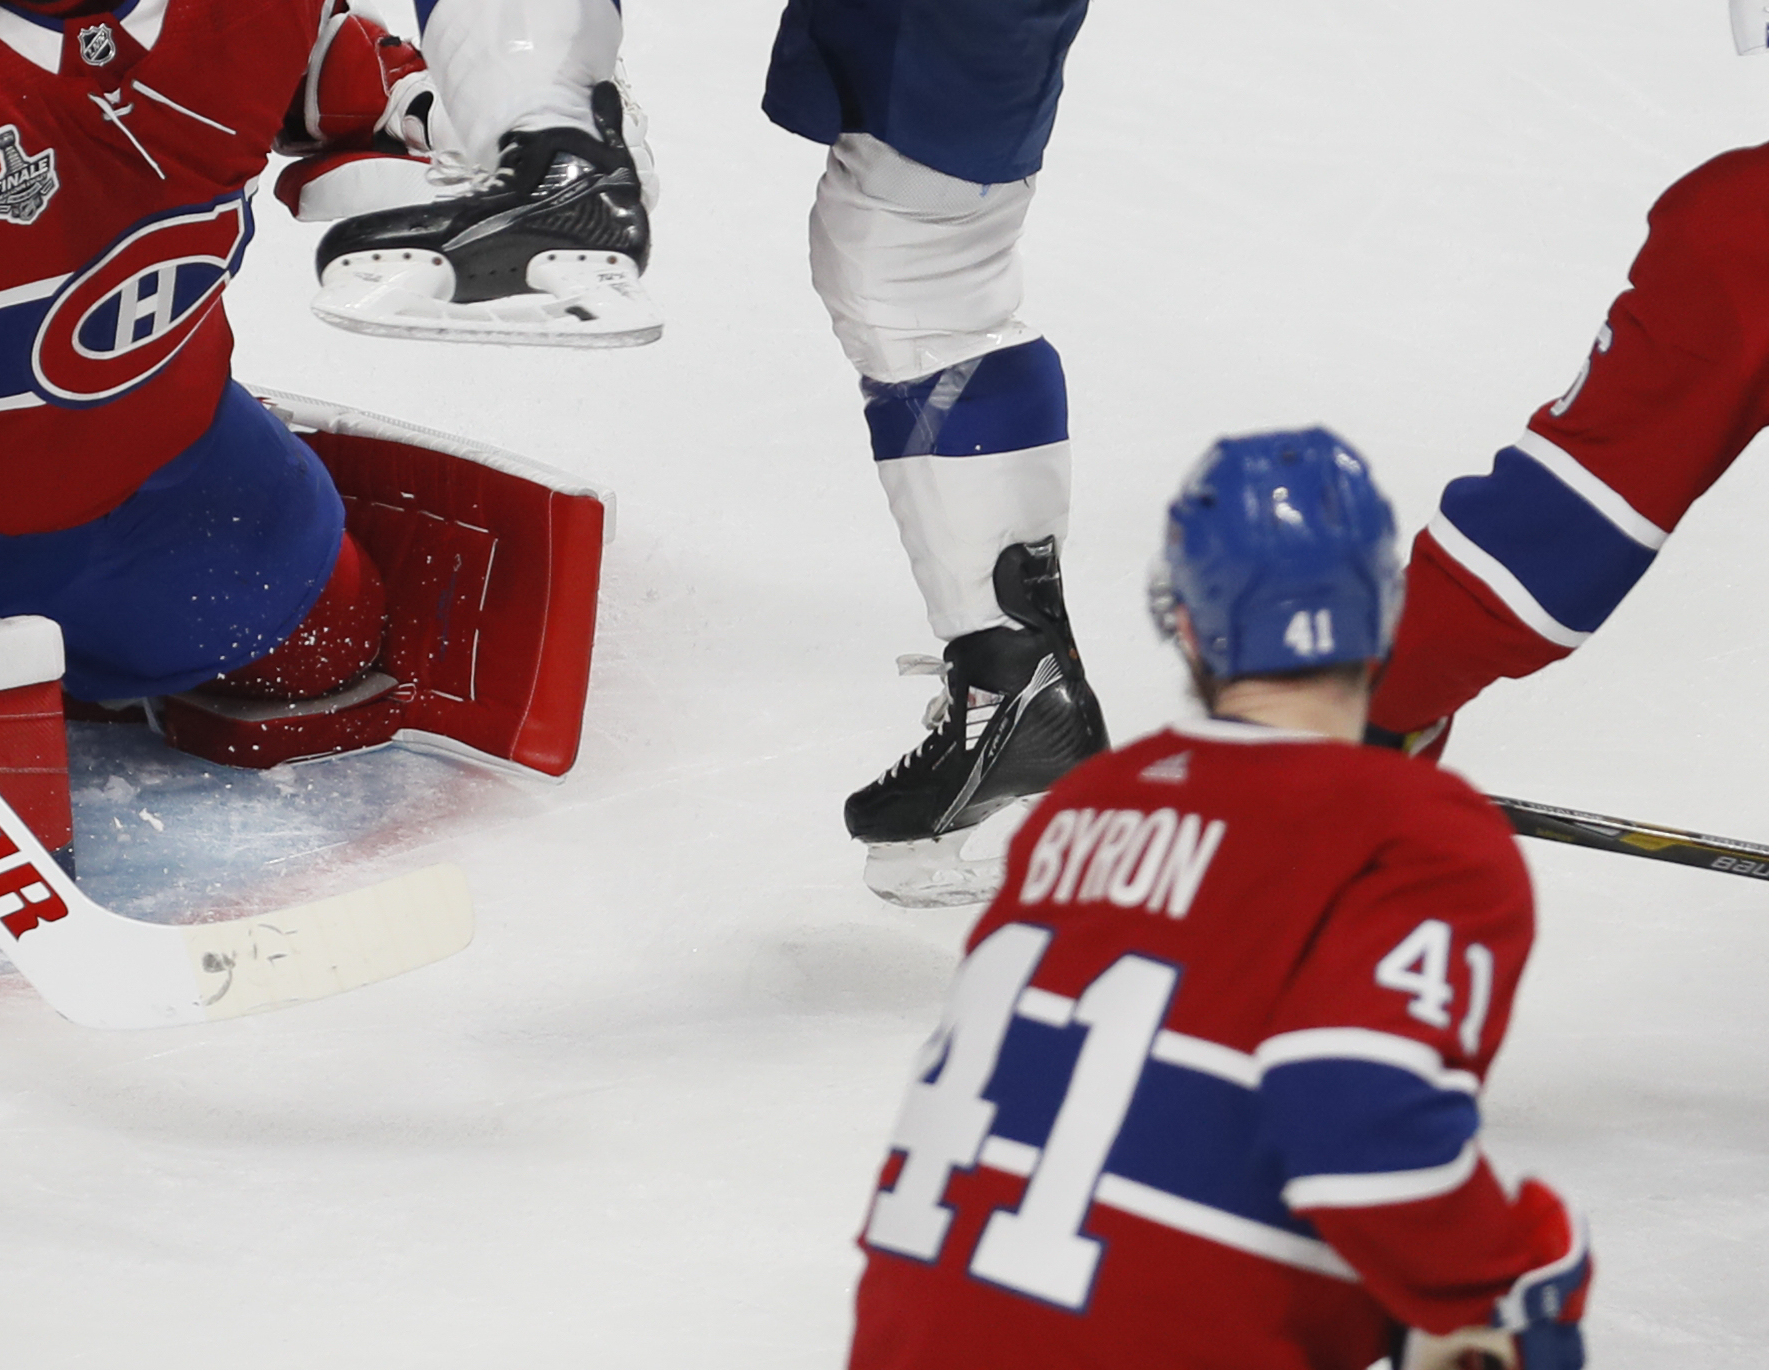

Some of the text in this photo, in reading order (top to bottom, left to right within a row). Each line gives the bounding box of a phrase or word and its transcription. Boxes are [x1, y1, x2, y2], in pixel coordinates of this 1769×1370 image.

[1283, 609, 1336, 657] 41
[1019, 806, 1227, 921] BYRON
[1375, 917, 1497, 1056] 41
[863, 921, 1186, 1316] 41
